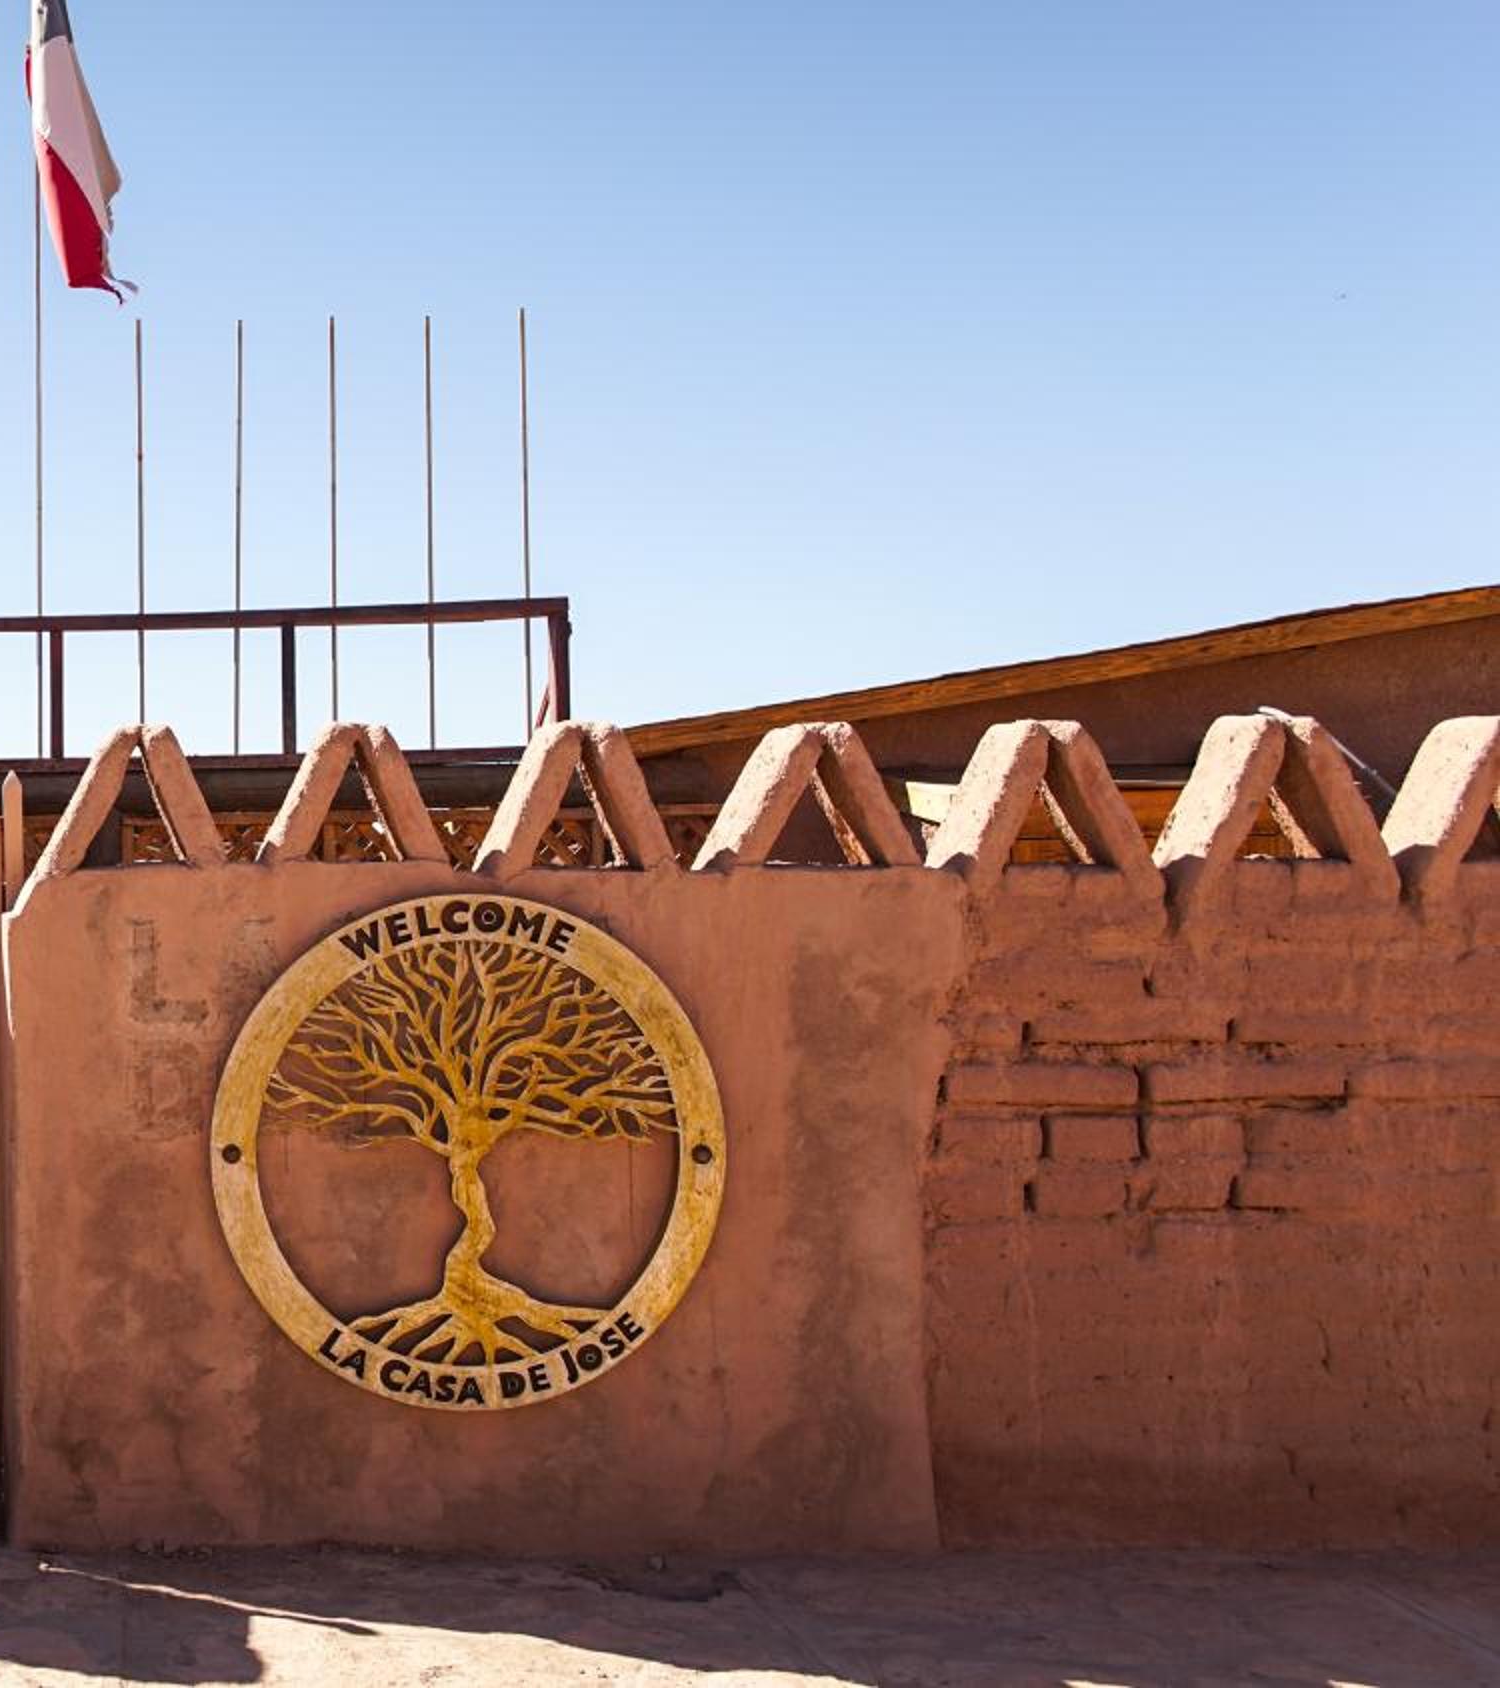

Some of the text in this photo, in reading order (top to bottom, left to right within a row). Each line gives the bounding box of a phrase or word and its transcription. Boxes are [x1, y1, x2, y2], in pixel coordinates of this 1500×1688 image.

[338, 899, 576, 962] WELCOME
[318, 1311, 645, 1405] LA CASA DE JOSE
